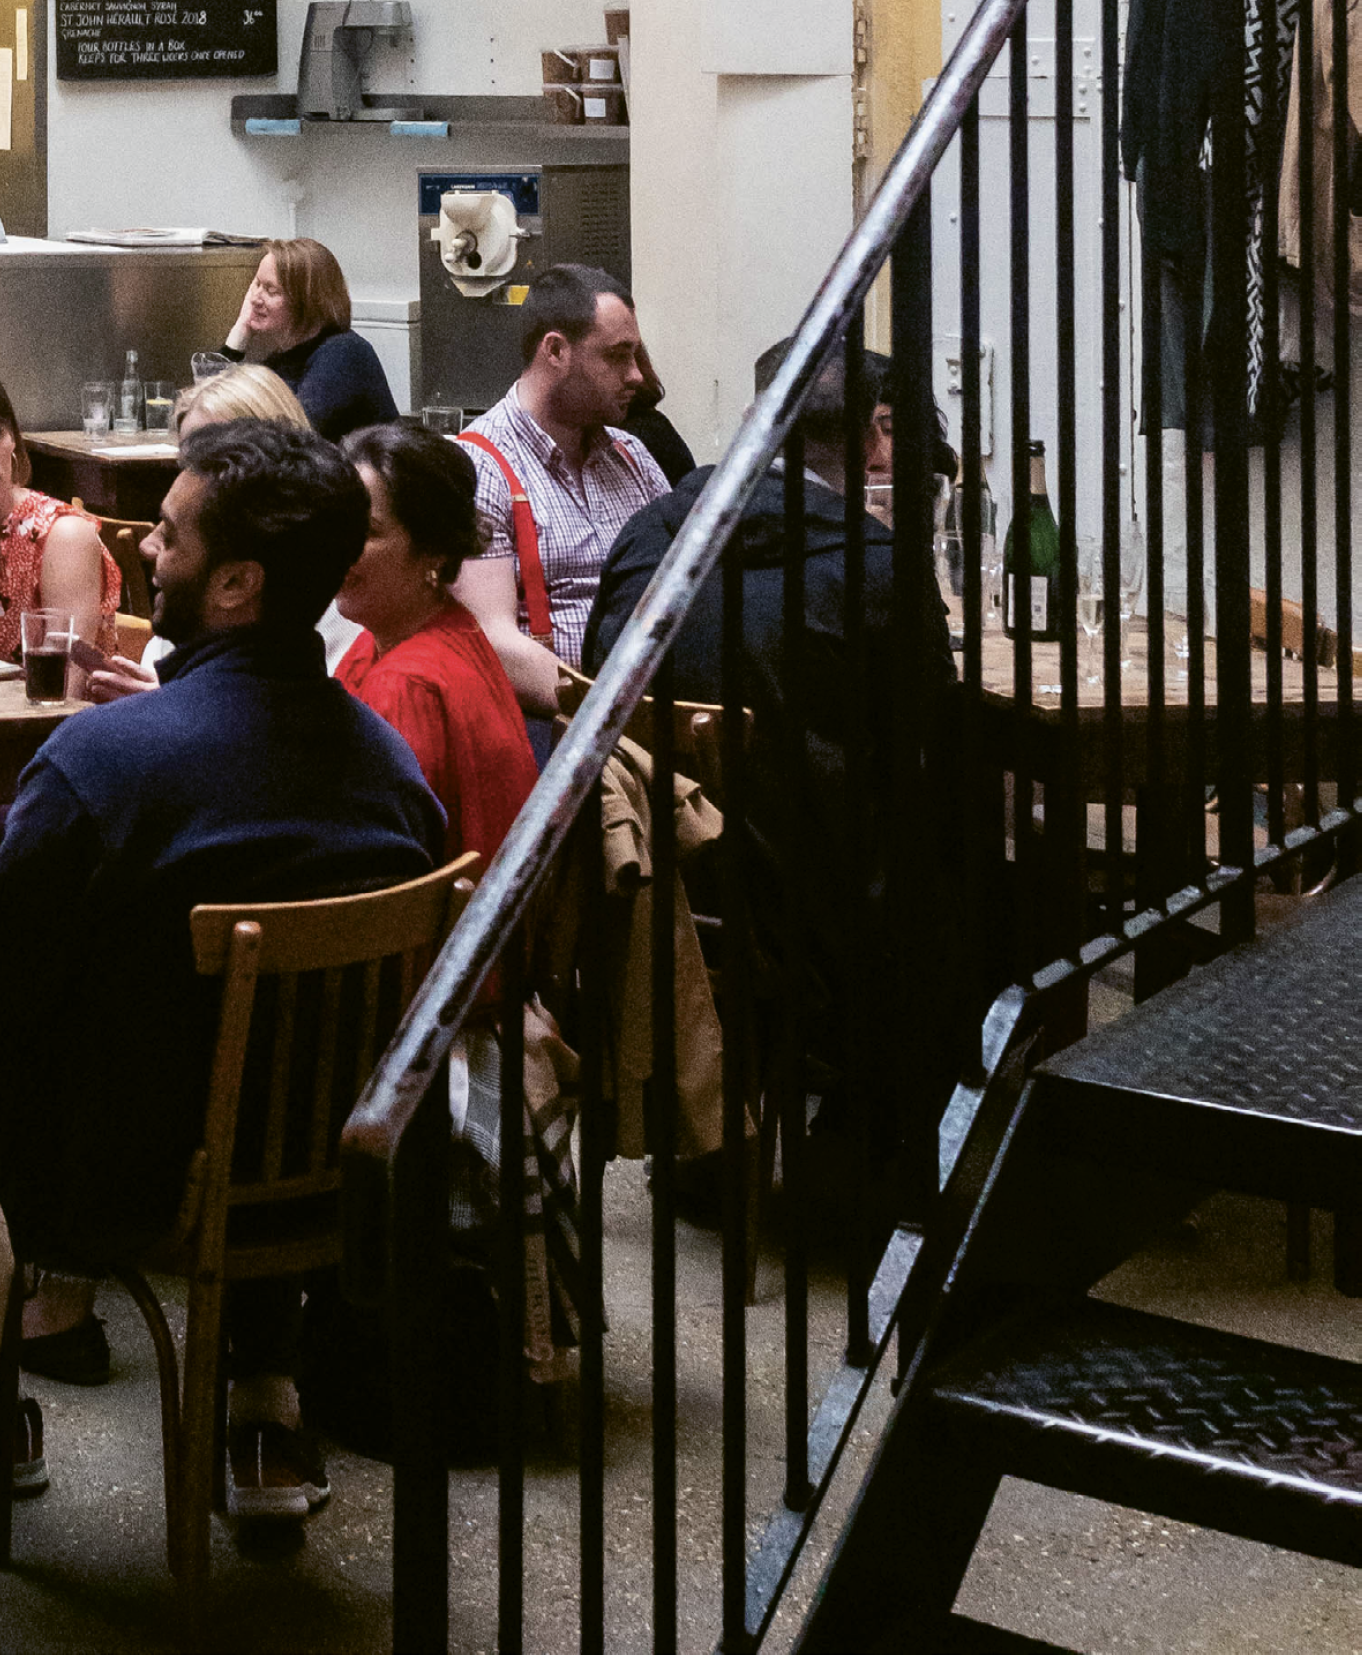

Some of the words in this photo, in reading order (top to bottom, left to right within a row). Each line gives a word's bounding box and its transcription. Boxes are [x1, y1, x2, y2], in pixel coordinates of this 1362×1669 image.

[59, 13, 74, 27] ST
[76, 13, 104, 27] JOHN
[181, 10, 207, 25] 2018
[78, 41, 100, 52] FOUR
[102, 40, 141, 52] BOTTLES
[145, 41, 155, 52] IN
[158, 41, 165, 51] A
[168, 38, 185, 51] BOX
[78, 52, 106, 64] KEEPS
[109, 52, 127, 64] FOR
[131, 52, 160, 64] THREE
[161, 51, 189, 63] WEEKS
[213, 49, 245, 60] OPENED
